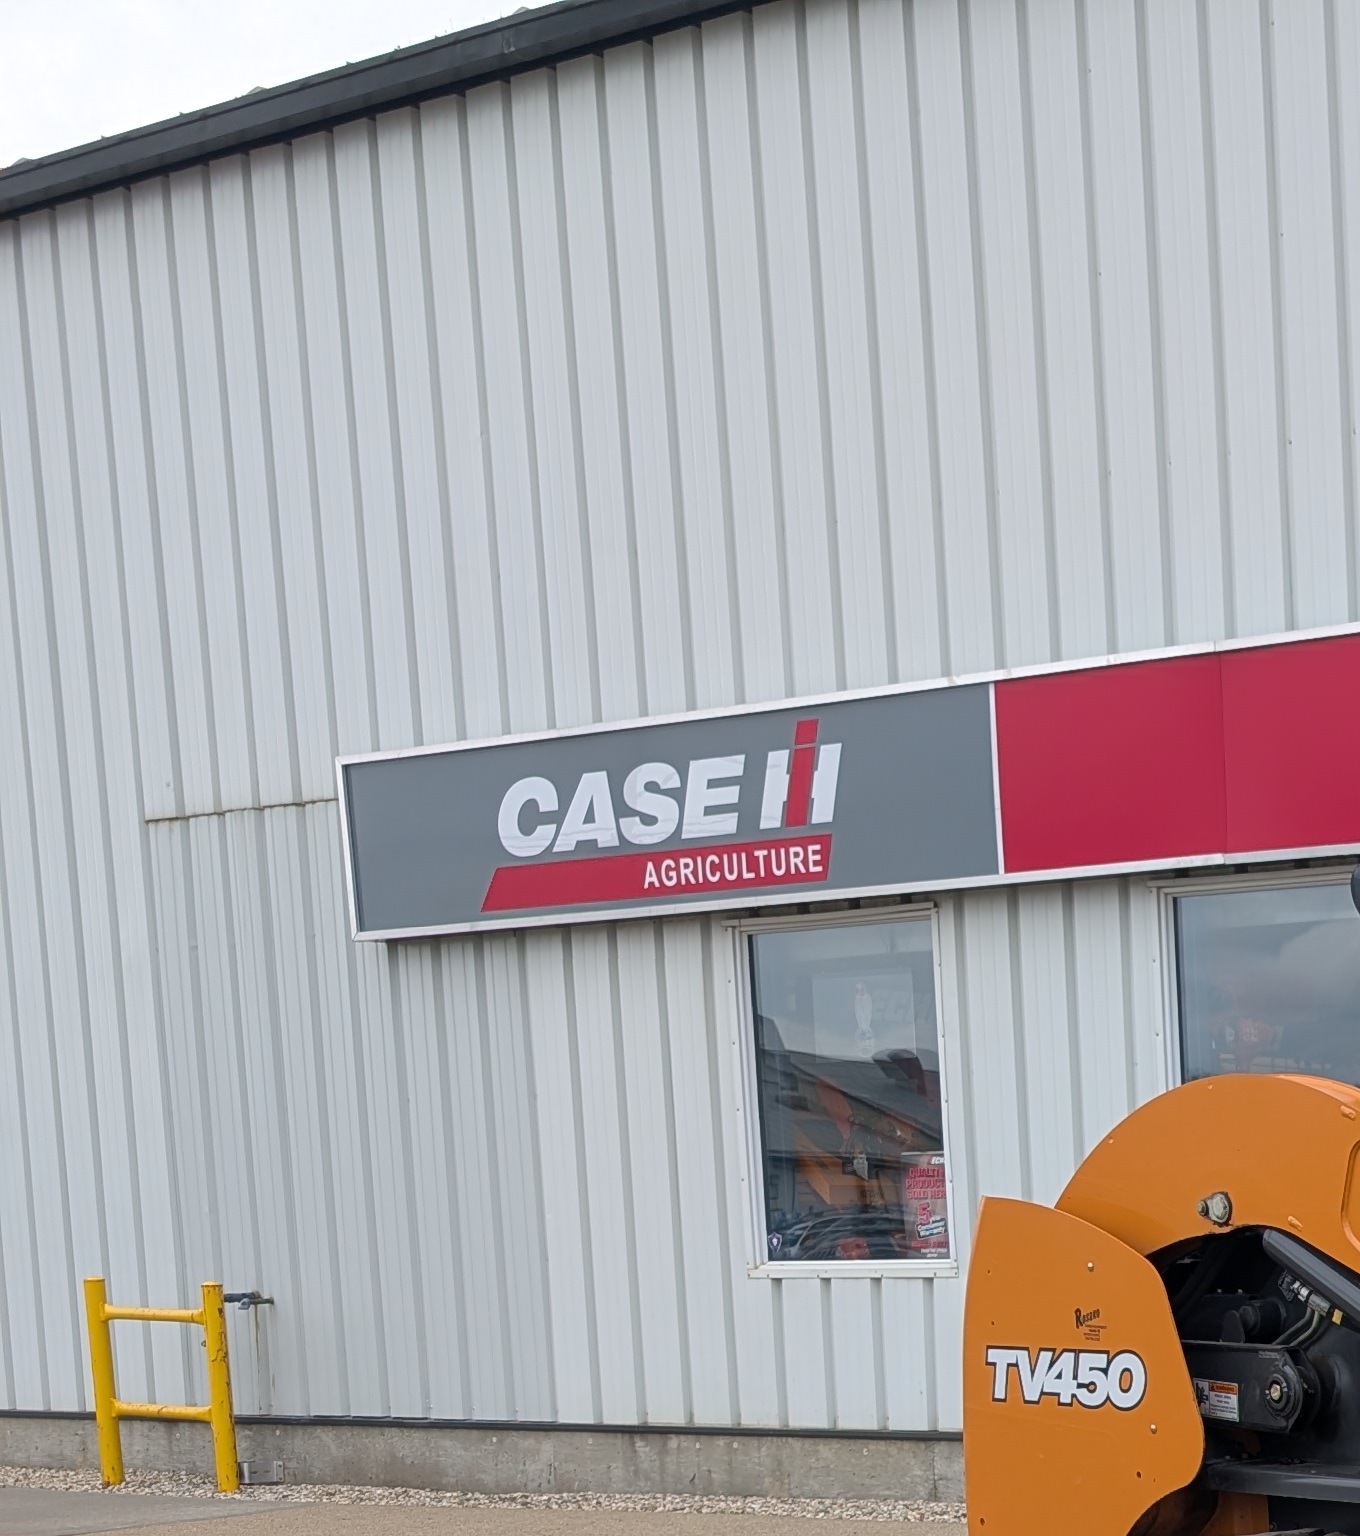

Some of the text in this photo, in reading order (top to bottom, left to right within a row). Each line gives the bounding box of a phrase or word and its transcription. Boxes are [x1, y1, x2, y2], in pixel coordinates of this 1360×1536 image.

[497, 753, 745, 858] CASE
[643, 843, 824, 890] AGRICULTURE
[985, 1345, 1147, 1411] TV450
